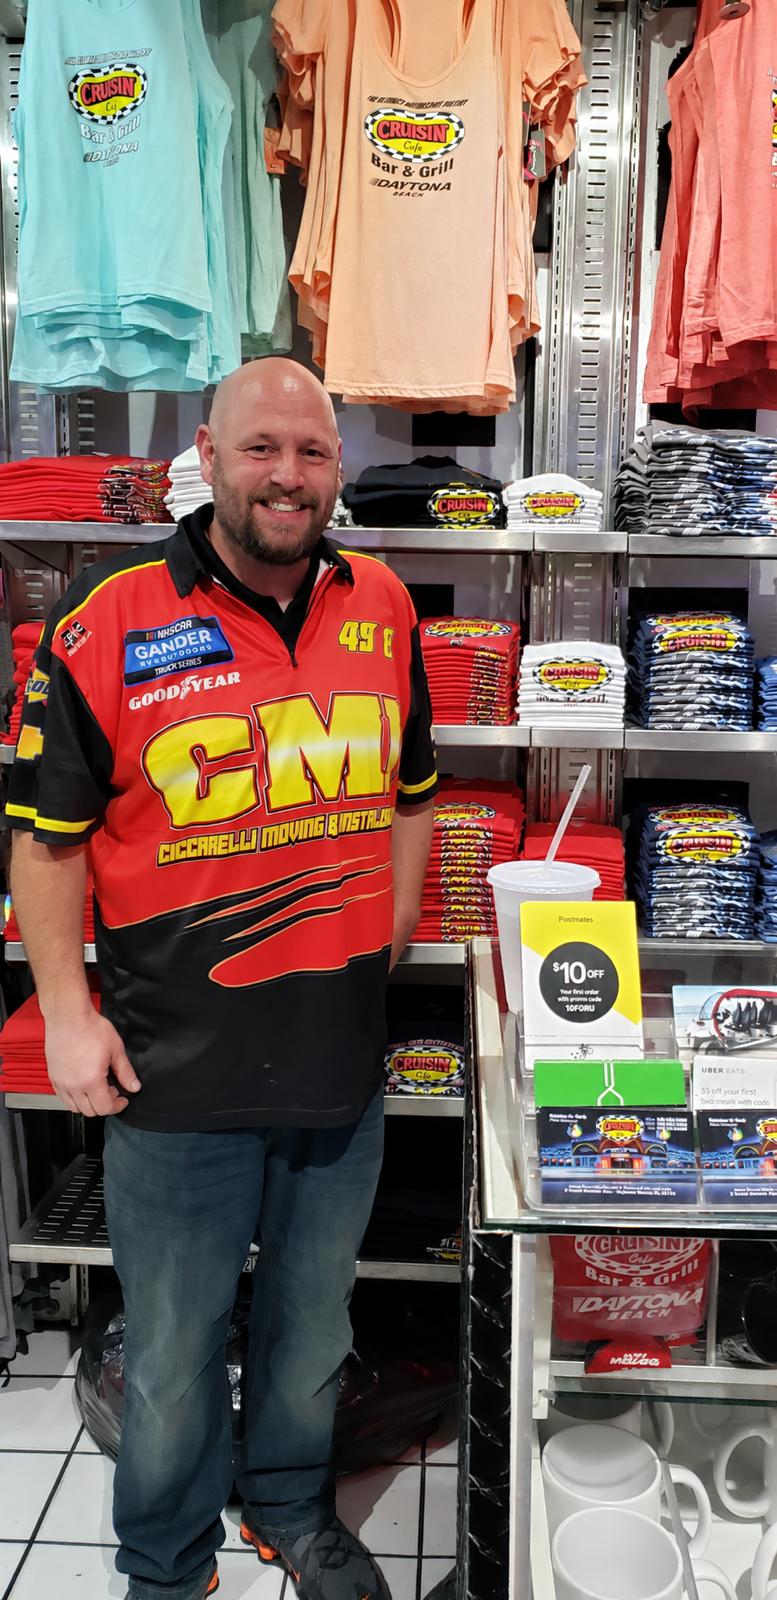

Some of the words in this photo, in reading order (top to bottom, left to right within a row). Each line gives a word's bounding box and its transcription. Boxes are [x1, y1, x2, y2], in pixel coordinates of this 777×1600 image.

[81, 124, 106, 144] Bar
[371, 153, 398, 175] Bar
[402, 165, 415, 177] &
[419, 158, 454, 178] Grill
[377, 179, 452, 192] DAYTONA
[157, 619, 193, 640] NASCAR
[338, 619, 380, 653] 49
[134, 629, 213, 660] GANDER
[155, 663, 178, 676] TRUCK
[128, 671, 241, 710] GOODYEAR
[156, 829, 259, 867] CICCARELLI
[260, 814, 325, 847] MOVING
[552, 961, 586, 984] $10
[587, 969, 605, 979] OFF
[565, 1004, 595, 1012] 10FORU
[724, 1088, 740, 1096] your
[585, 1265, 623, 1287] Bar
[629, 1276, 647, 1288] &
[653, 1259, 699, 1286] Grill
[578, 1287, 704, 1313] DAYTONA
[607, 1308, 672, 1321] BEACH
